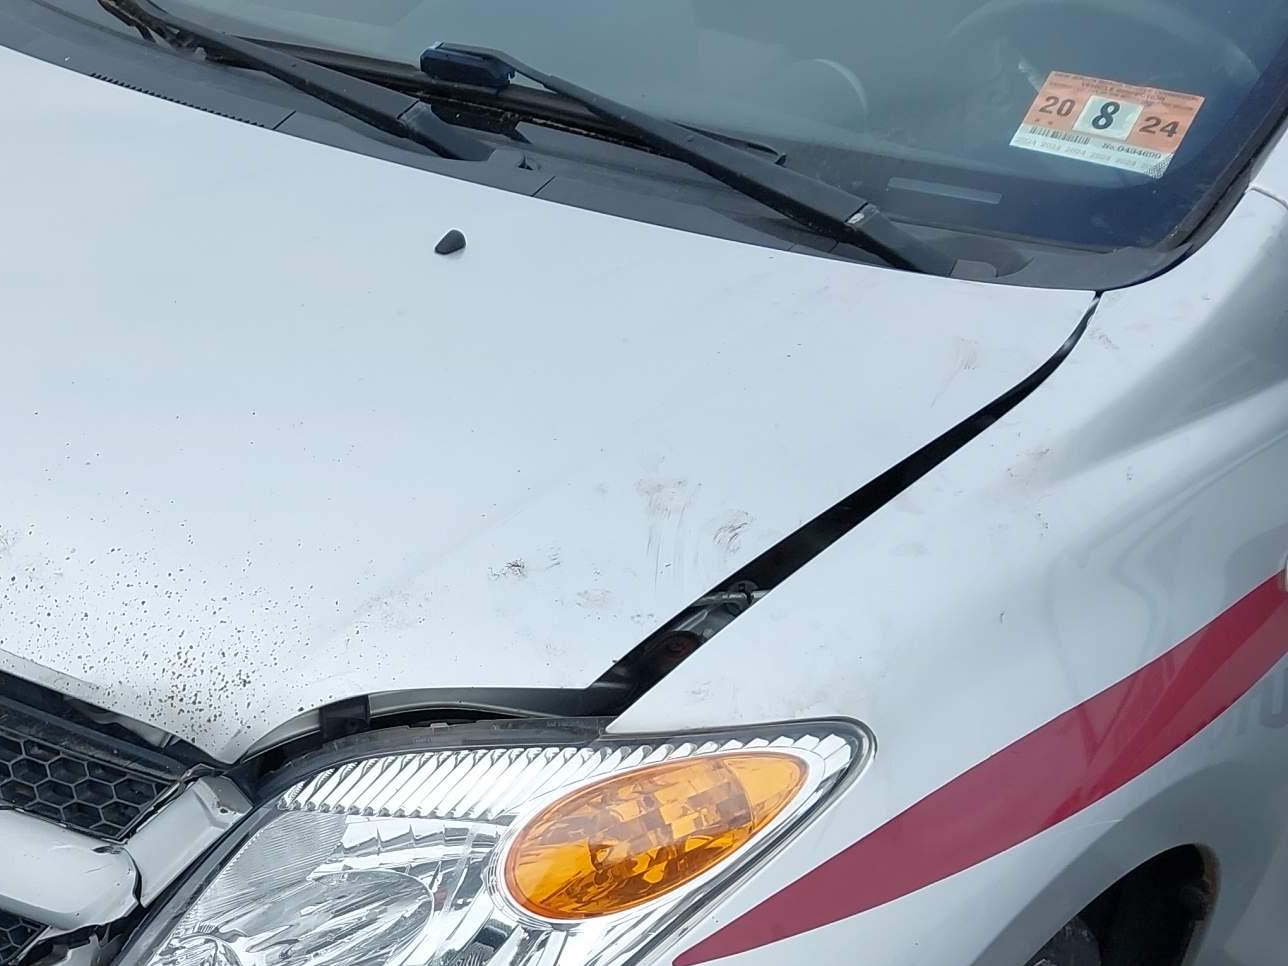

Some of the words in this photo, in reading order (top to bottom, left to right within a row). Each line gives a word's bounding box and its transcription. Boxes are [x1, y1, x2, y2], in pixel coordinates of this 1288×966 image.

[1039, 95, 1075, 117] 20
[1091, 101, 1120, 130] 8
[1139, 116, 1179, 138] 24
